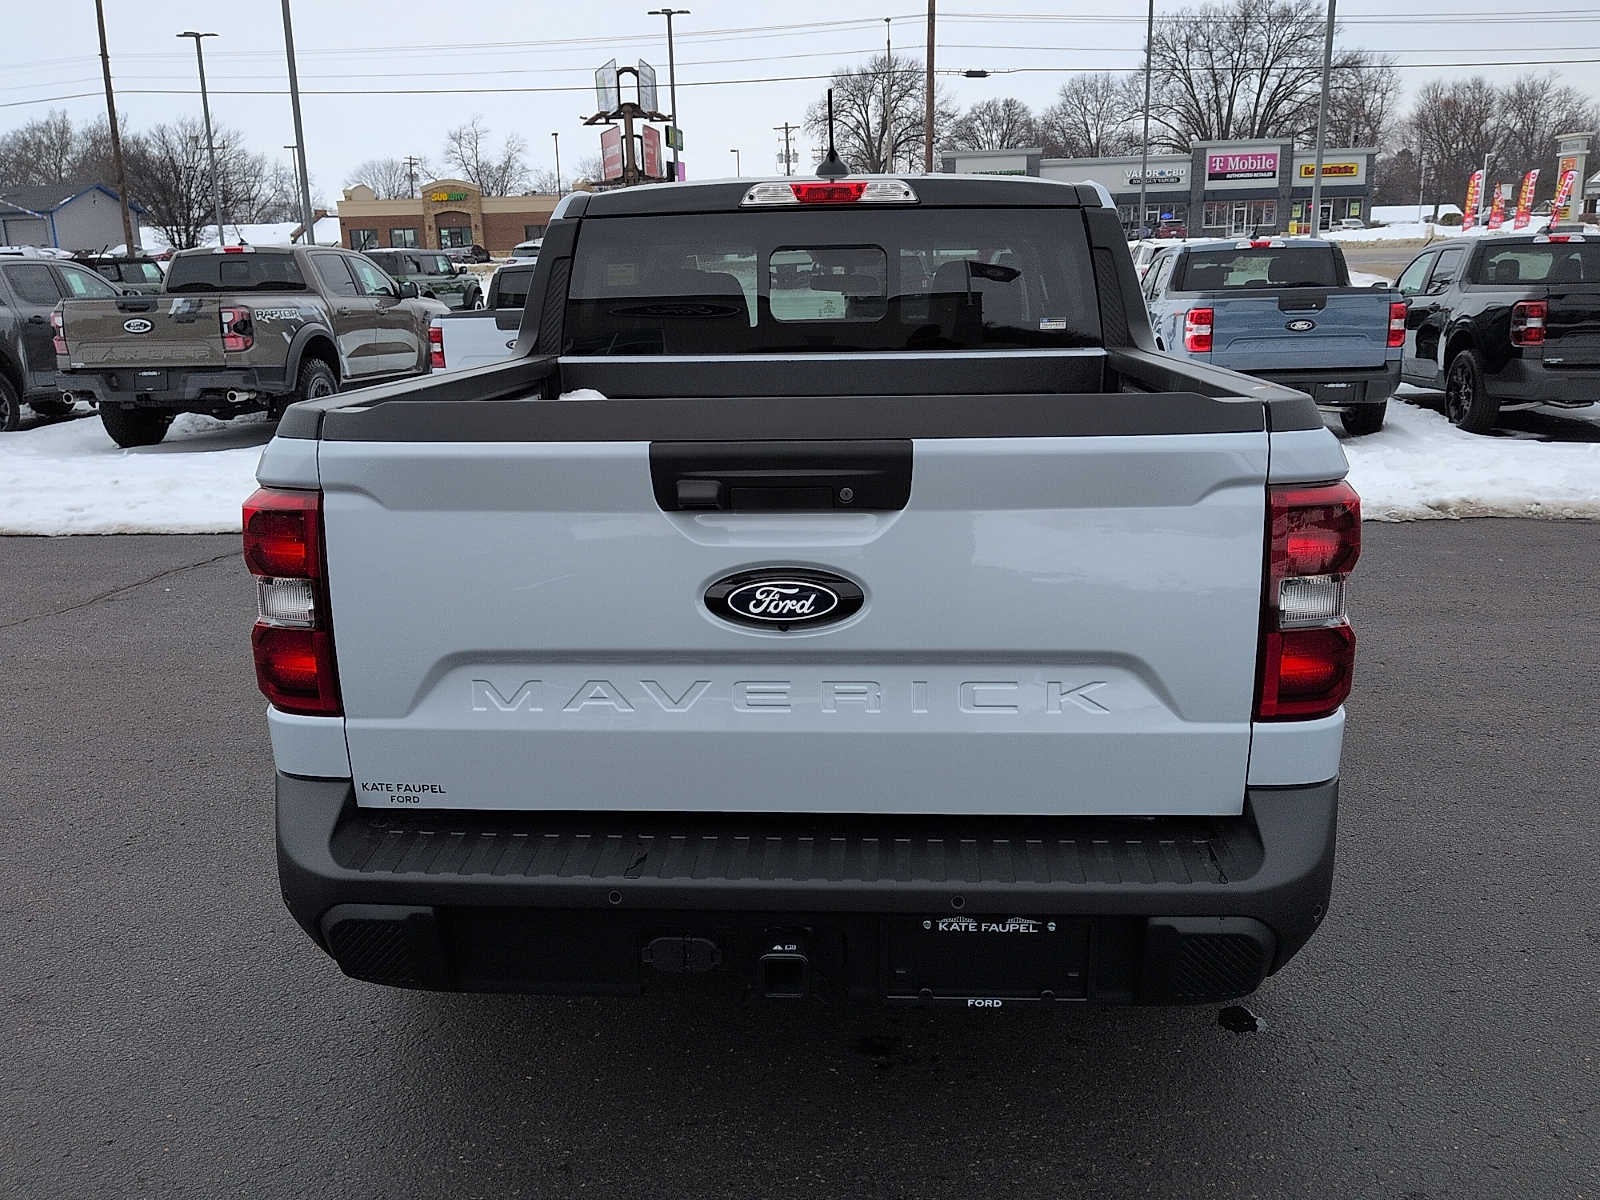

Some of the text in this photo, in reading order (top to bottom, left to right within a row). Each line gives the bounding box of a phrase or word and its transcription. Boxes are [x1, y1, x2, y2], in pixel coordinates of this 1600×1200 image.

[1227, 156, 1274, 171] Mobile
[1165, 168, 1186, 176] CBD
[431, 191, 468, 201] SUBWAY
[255, 308, 304, 323] RAPTOR
[748, 586, 816, 615] Ford
[471, 679, 1111, 715] MAVERICK
[361, 782, 447, 794] KATE FAUPEL
[390, 795, 420, 804] FORD
[938, 922, 1039, 933] KATE FAUPEL
[967, 1000, 1002, 1008] FORD
